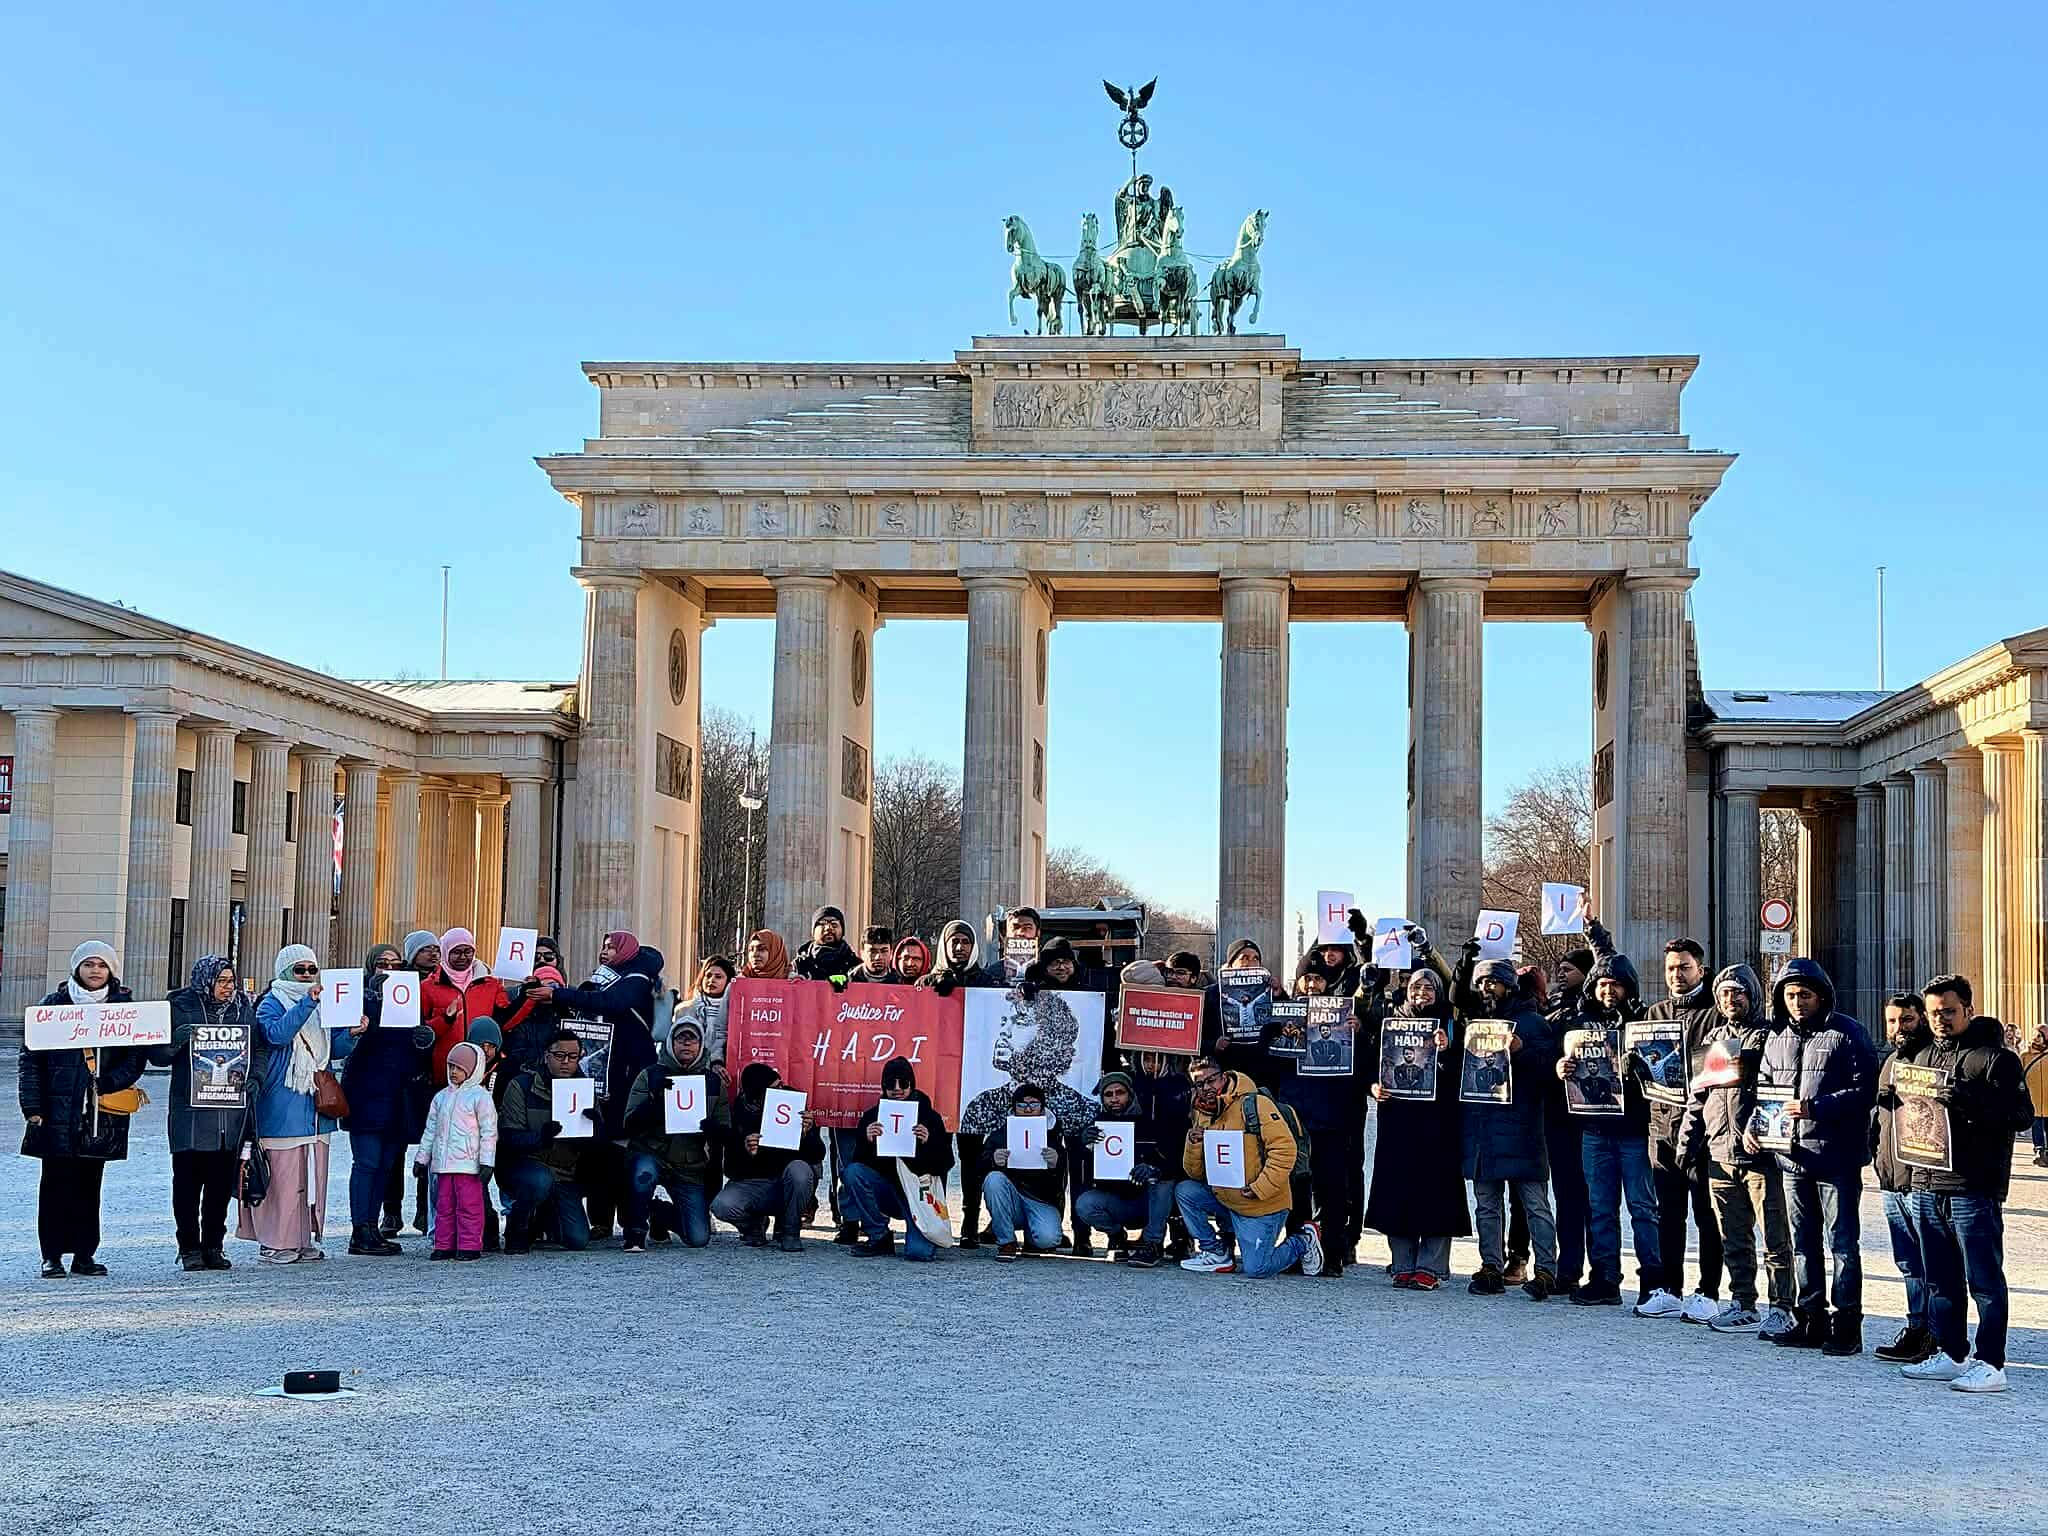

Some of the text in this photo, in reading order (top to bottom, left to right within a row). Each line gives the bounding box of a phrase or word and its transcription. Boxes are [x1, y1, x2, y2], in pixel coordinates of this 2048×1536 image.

[1328, 904, 1345, 922] H
[1383, 927, 1401, 946] A
[1486, 922, 1504, 941] D
[509, 942, 524, 961] R
[1007, 939, 1036, 948] STOP
[1229, 976, 1263, 985] KILLERS
[335, 983, 349, 1003] F
[392, 984, 410, 1005] O
[837, 1001, 905, 1023] Justice For
[1272, 1007, 1307, 1016] KILLERS
[1308, 997, 1344, 1009] INSAF
[100, 1009, 138, 1021] Justice
[751, 1009, 781, 1022] HADI
[1310, 1011, 1340, 1023] HADI
[69, 1023, 90, 1041] for
[98, 1023, 132, 1038] HADI
[197, 1027, 243, 1041] STOP
[1386, 1020, 1433, 1032] JUSTICE
[194, 1040, 246, 1050] HEGEMONY
[1394, 1035, 1424, 1047] HADI
[1575, 1047, 1606, 1059] HADI
[1911, 1069, 1937, 1084] DAYS
[568, 1092, 577, 1114] J
[676, 1089, 694, 1111] U
[775, 1103, 791, 1125] S
[889, 1114, 905, 1134] T
[1105, 1135, 1123, 1156] C
[1217, 1144, 1232, 1165] E
